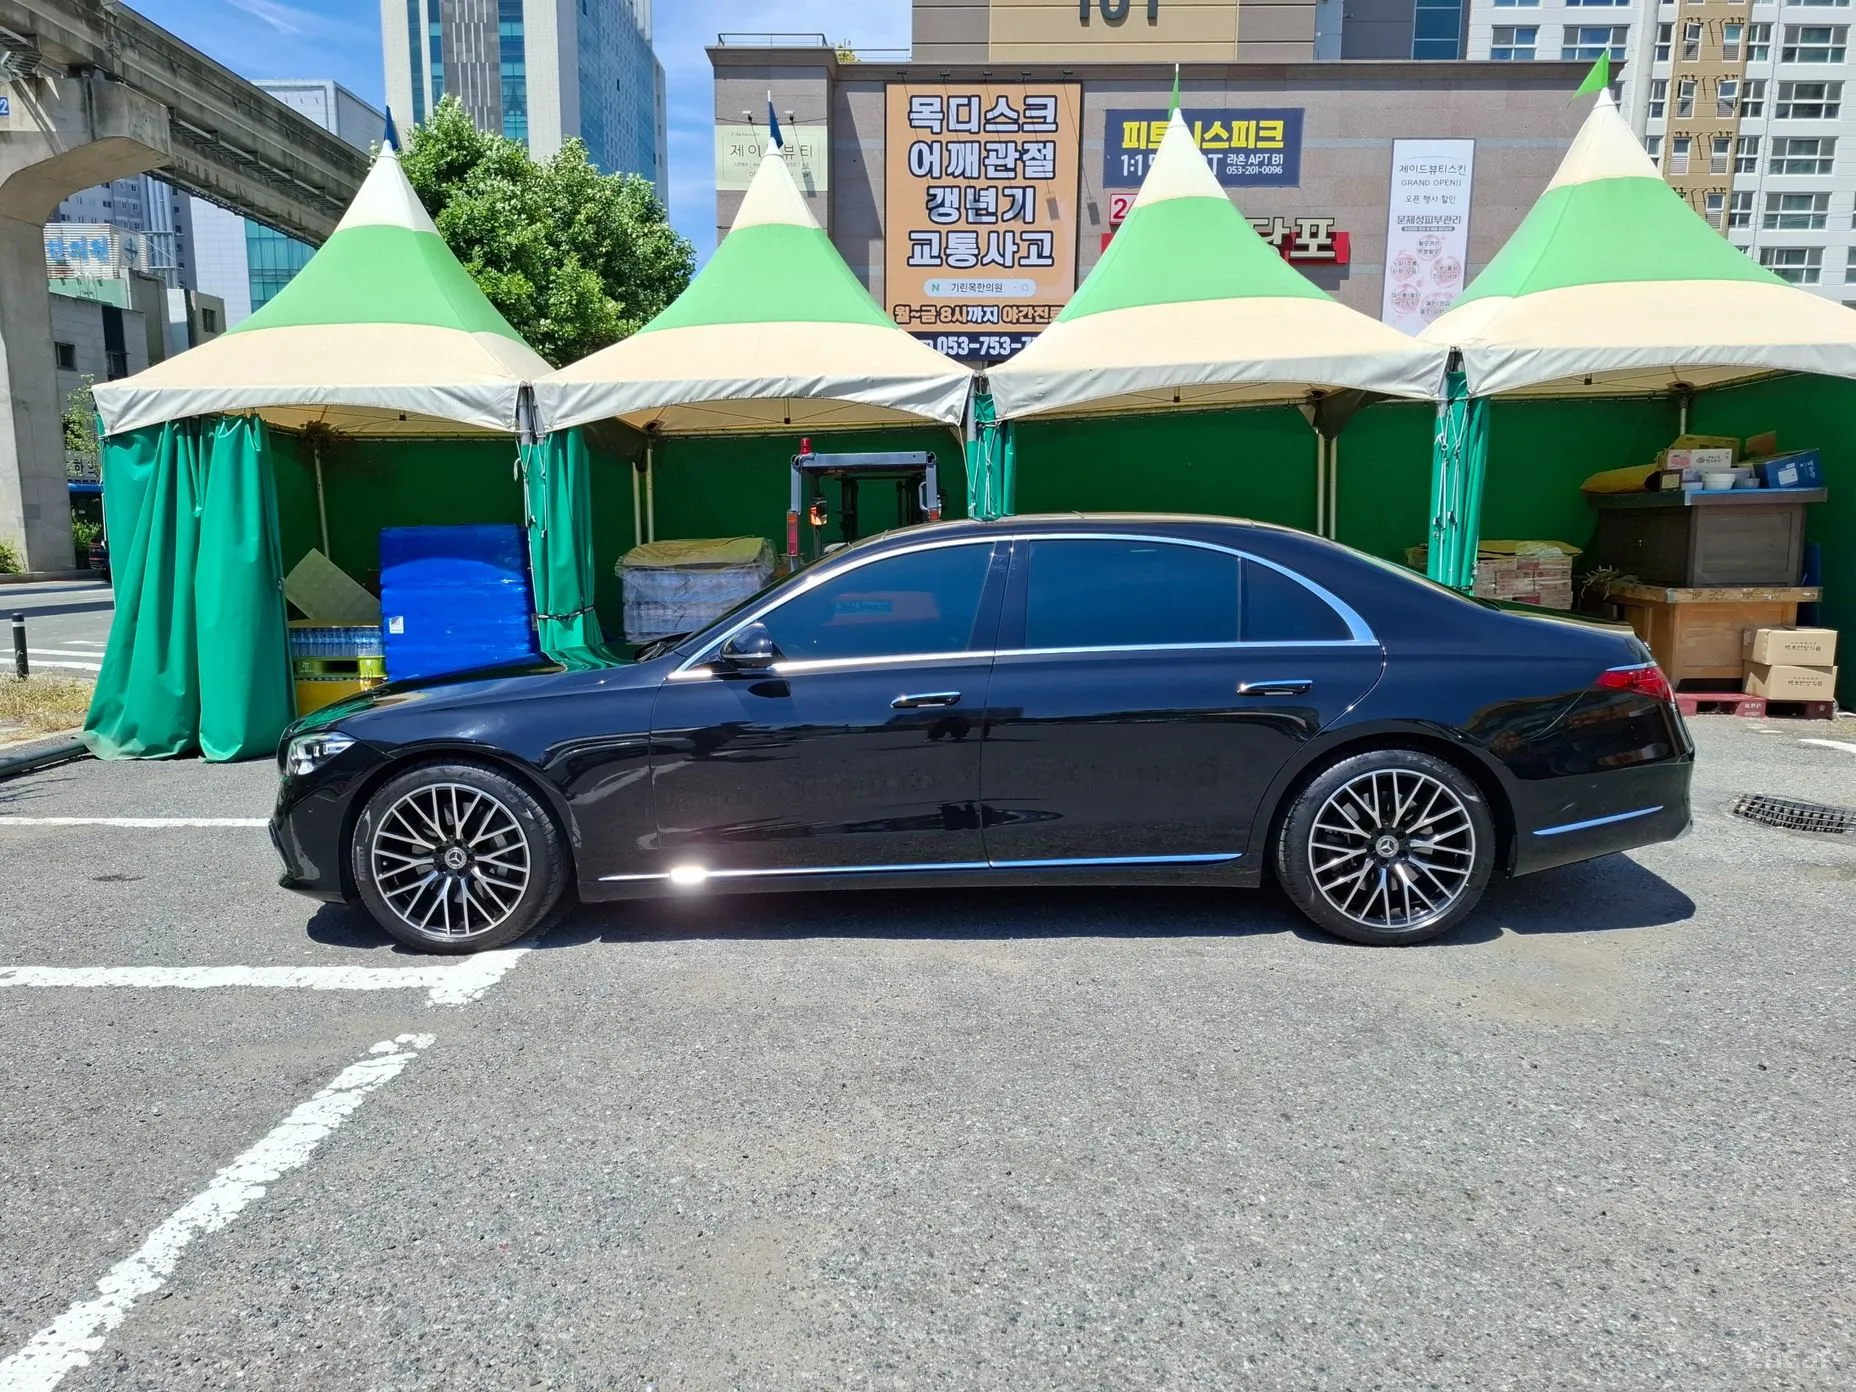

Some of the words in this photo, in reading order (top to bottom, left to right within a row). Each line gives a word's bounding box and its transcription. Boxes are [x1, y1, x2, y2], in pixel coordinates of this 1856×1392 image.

[908, 95, 1058, 134] 목디스크
[730, 144, 813, 161] 제이뷰티
[908, 140, 1056, 180] 어깨관절
[1248, 154, 1270, 165] APT
[1120, 154, 1143, 176] 1:1
[1226, 166, 1283, 175] 053-201-0096
[1399, 164, 1467, 175] 제이드뷰티스킨
[1401, 179, 1430, 187] GRAND
[926, 186, 1036, 225] 갱년기
[1397, 215, 1461, 225] 문제성피부관리
[907, 229, 1054, 268] 교통사고
[951, 283, 1003, 293] 기린목한의원
[894, 304, 938, 325] 월~금
[940, 304, 999, 325] 8시까지
[936, 336, 1035, 355] 053-753-7
